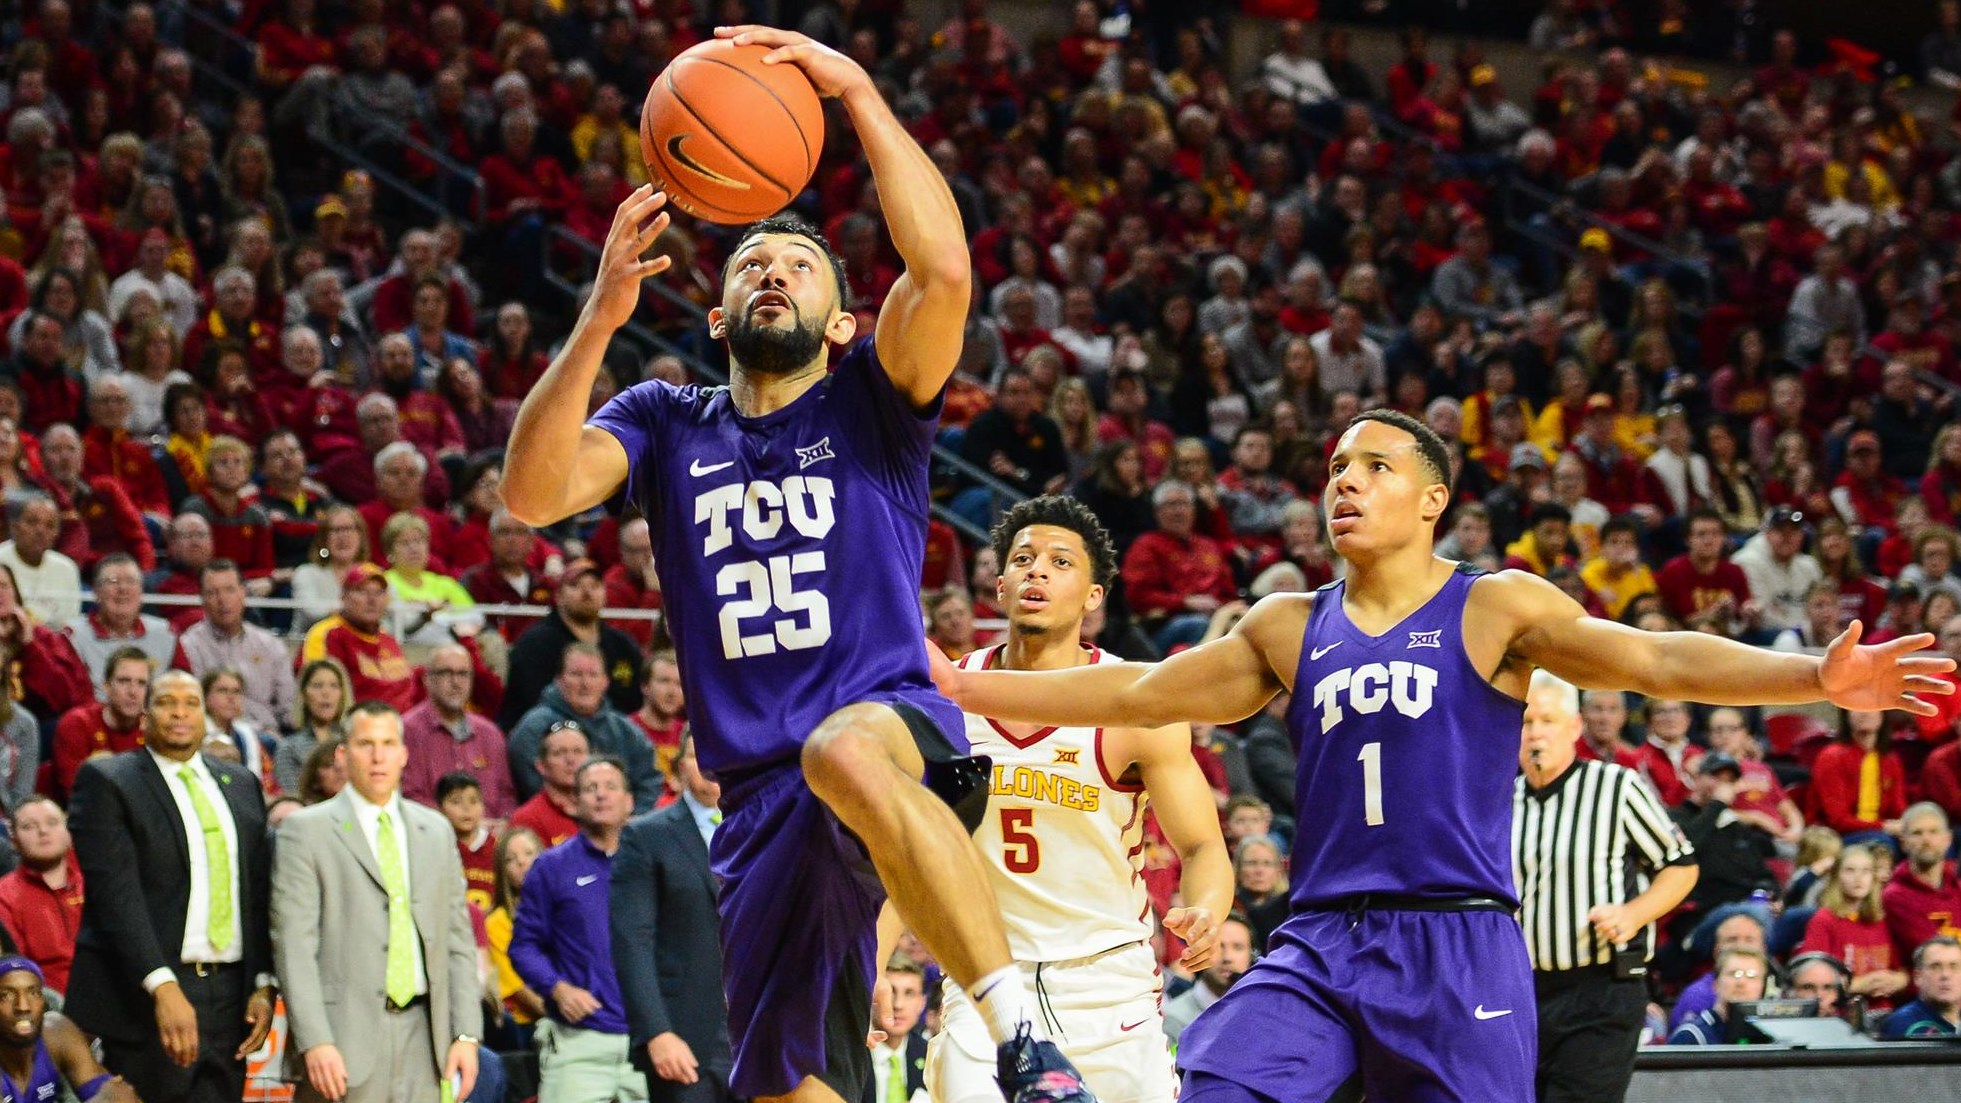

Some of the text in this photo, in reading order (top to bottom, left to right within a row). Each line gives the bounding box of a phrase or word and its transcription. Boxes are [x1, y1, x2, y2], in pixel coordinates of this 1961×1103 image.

[694, 475, 836, 557] TCU
[716, 550, 832, 660] 25
[1313, 660, 1439, 735] TCU
[988, 764, 1101, 813] LONES
[1356, 742, 1385, 826] 1
[999, 807, 1041, 874] 5
